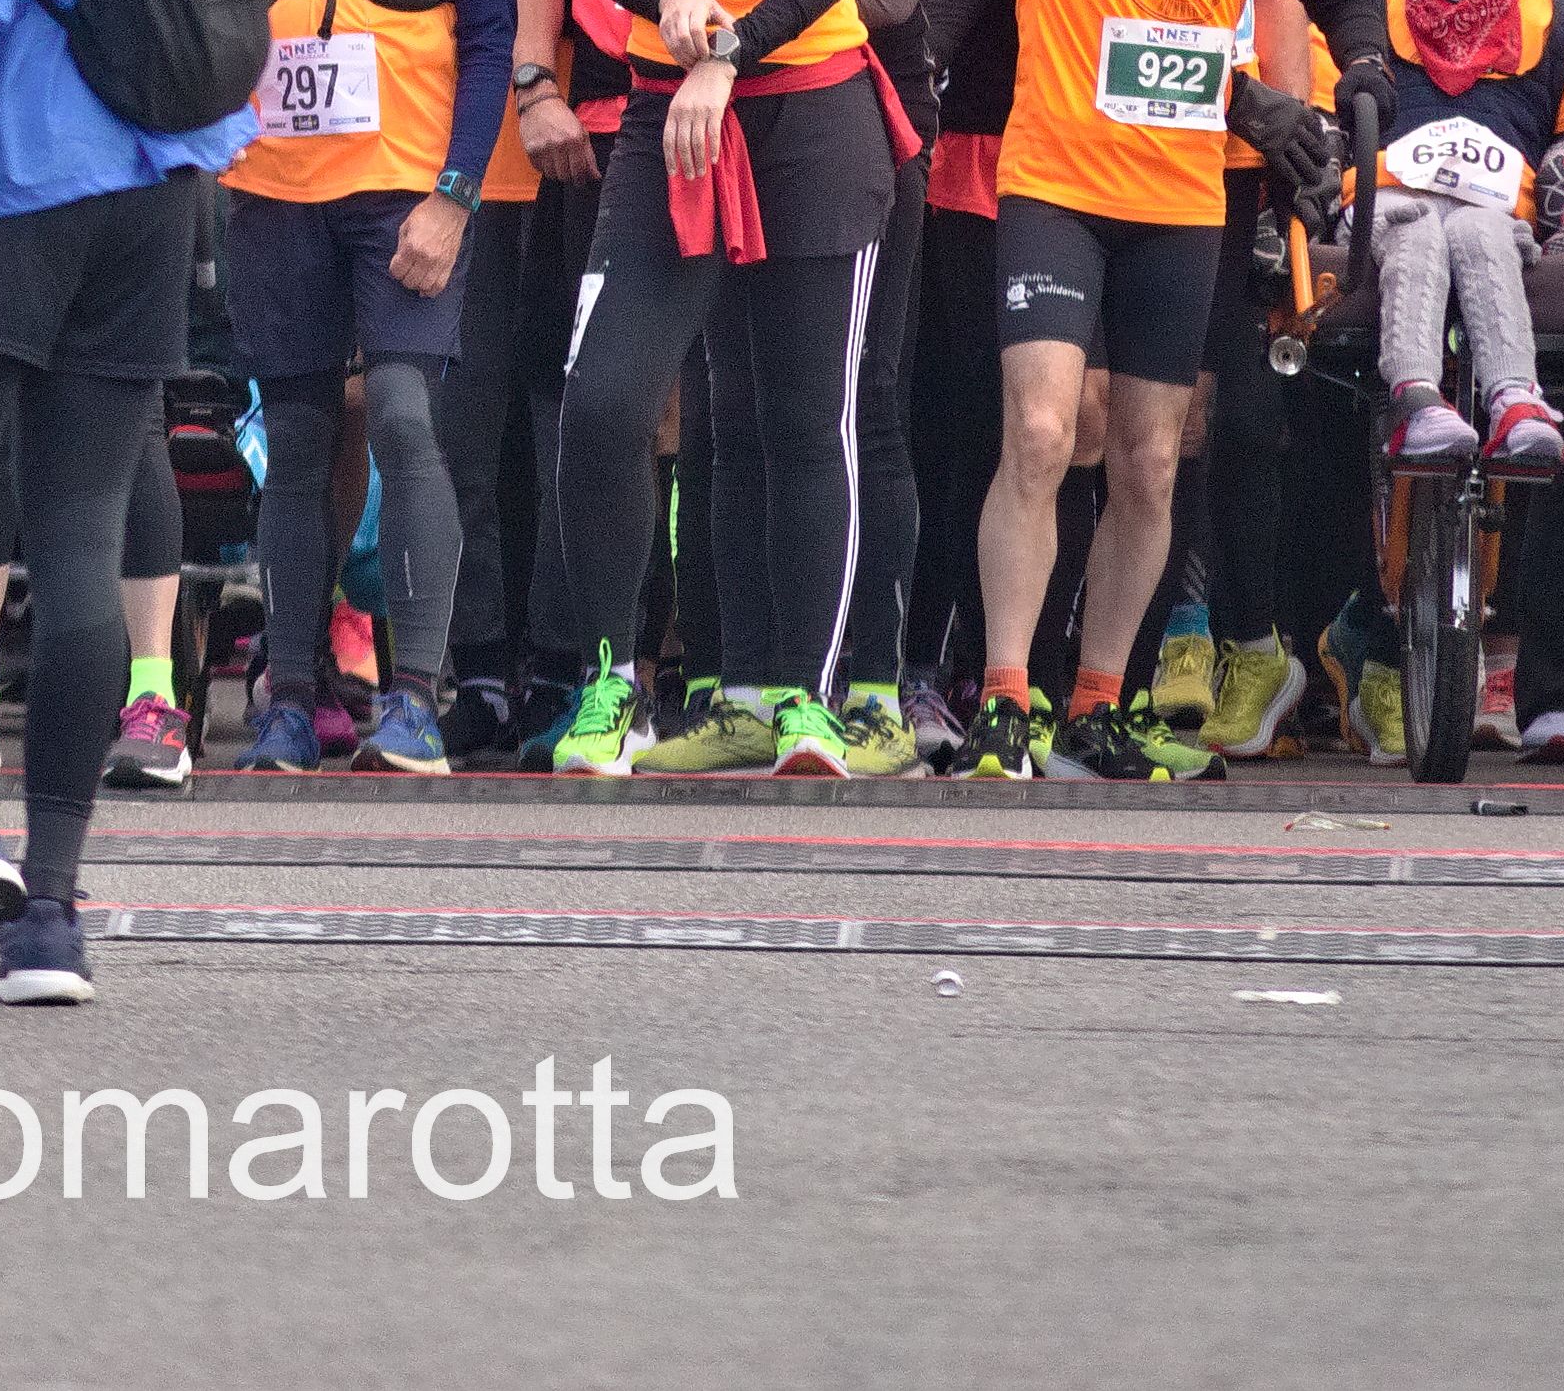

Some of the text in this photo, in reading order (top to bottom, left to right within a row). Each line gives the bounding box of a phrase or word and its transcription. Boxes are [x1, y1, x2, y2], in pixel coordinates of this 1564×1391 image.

[294, 41, 329, 55] NET
[1166, 28, 1202, 42] NET
[276, 63, 340, 112] 297
[1137, 51, 1208, 93] 922
[1412, 137, 1506, 174] 6350
